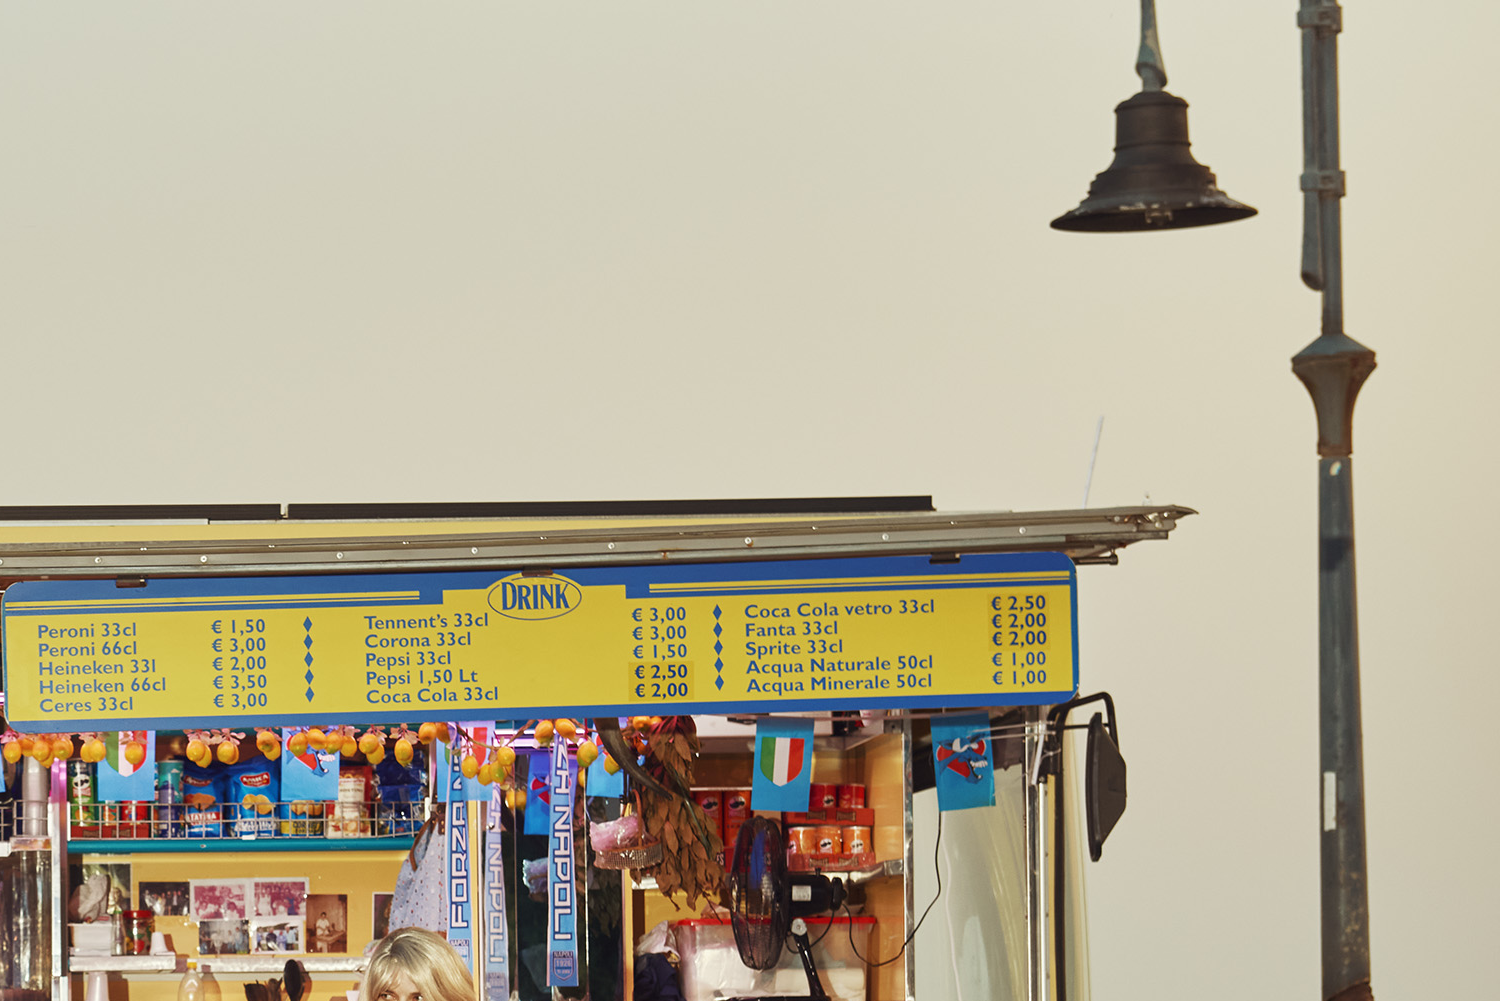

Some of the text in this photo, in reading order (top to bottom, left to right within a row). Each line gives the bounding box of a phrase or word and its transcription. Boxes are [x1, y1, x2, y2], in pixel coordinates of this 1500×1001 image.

[501, 580, 572, 611] DRINK
[744, 594, 1046, 619] Coca Cola vetro 33cl € 2,50
[37, 618, 266, 639] Peroni 33cl € 1,50
[363, 606, 687, 630] Tennent's 33cl € 3,00
[745, 612, 1047, 638] Fanta 33cl € 2,00
[38, 636, 266, 658] Peroni 66cl € 3,00
[364, 624, 687, 649] Corona 33cl € 3,00
[745, 630, 1047, 660] Sprite 33cl € 2,00
[38, 655, 267, 676] Heineken 33l € 2,00
[365, 643, 688, 670] Pepsi 33cl € 1,50
[746, 651, 1046, 678] Acqua Naturale 50cl € 1,00
[39, 674, 267, 695] Heineken 66cl € 3,50
[366, 663, 688, 690] Pepsi 1,50 Lt € 2,50
[746, 669, 1047, 697] Acqua Minerale 50cl € 1,00
[39, 692, 268, 713] Ceres 33cl € 3,00
[366, 682, 689, 704] Coca Cola 33cl € 2,00
[451, 800, 469, 930] FORZA
[553, 804, 573, 941] NAPOLI
